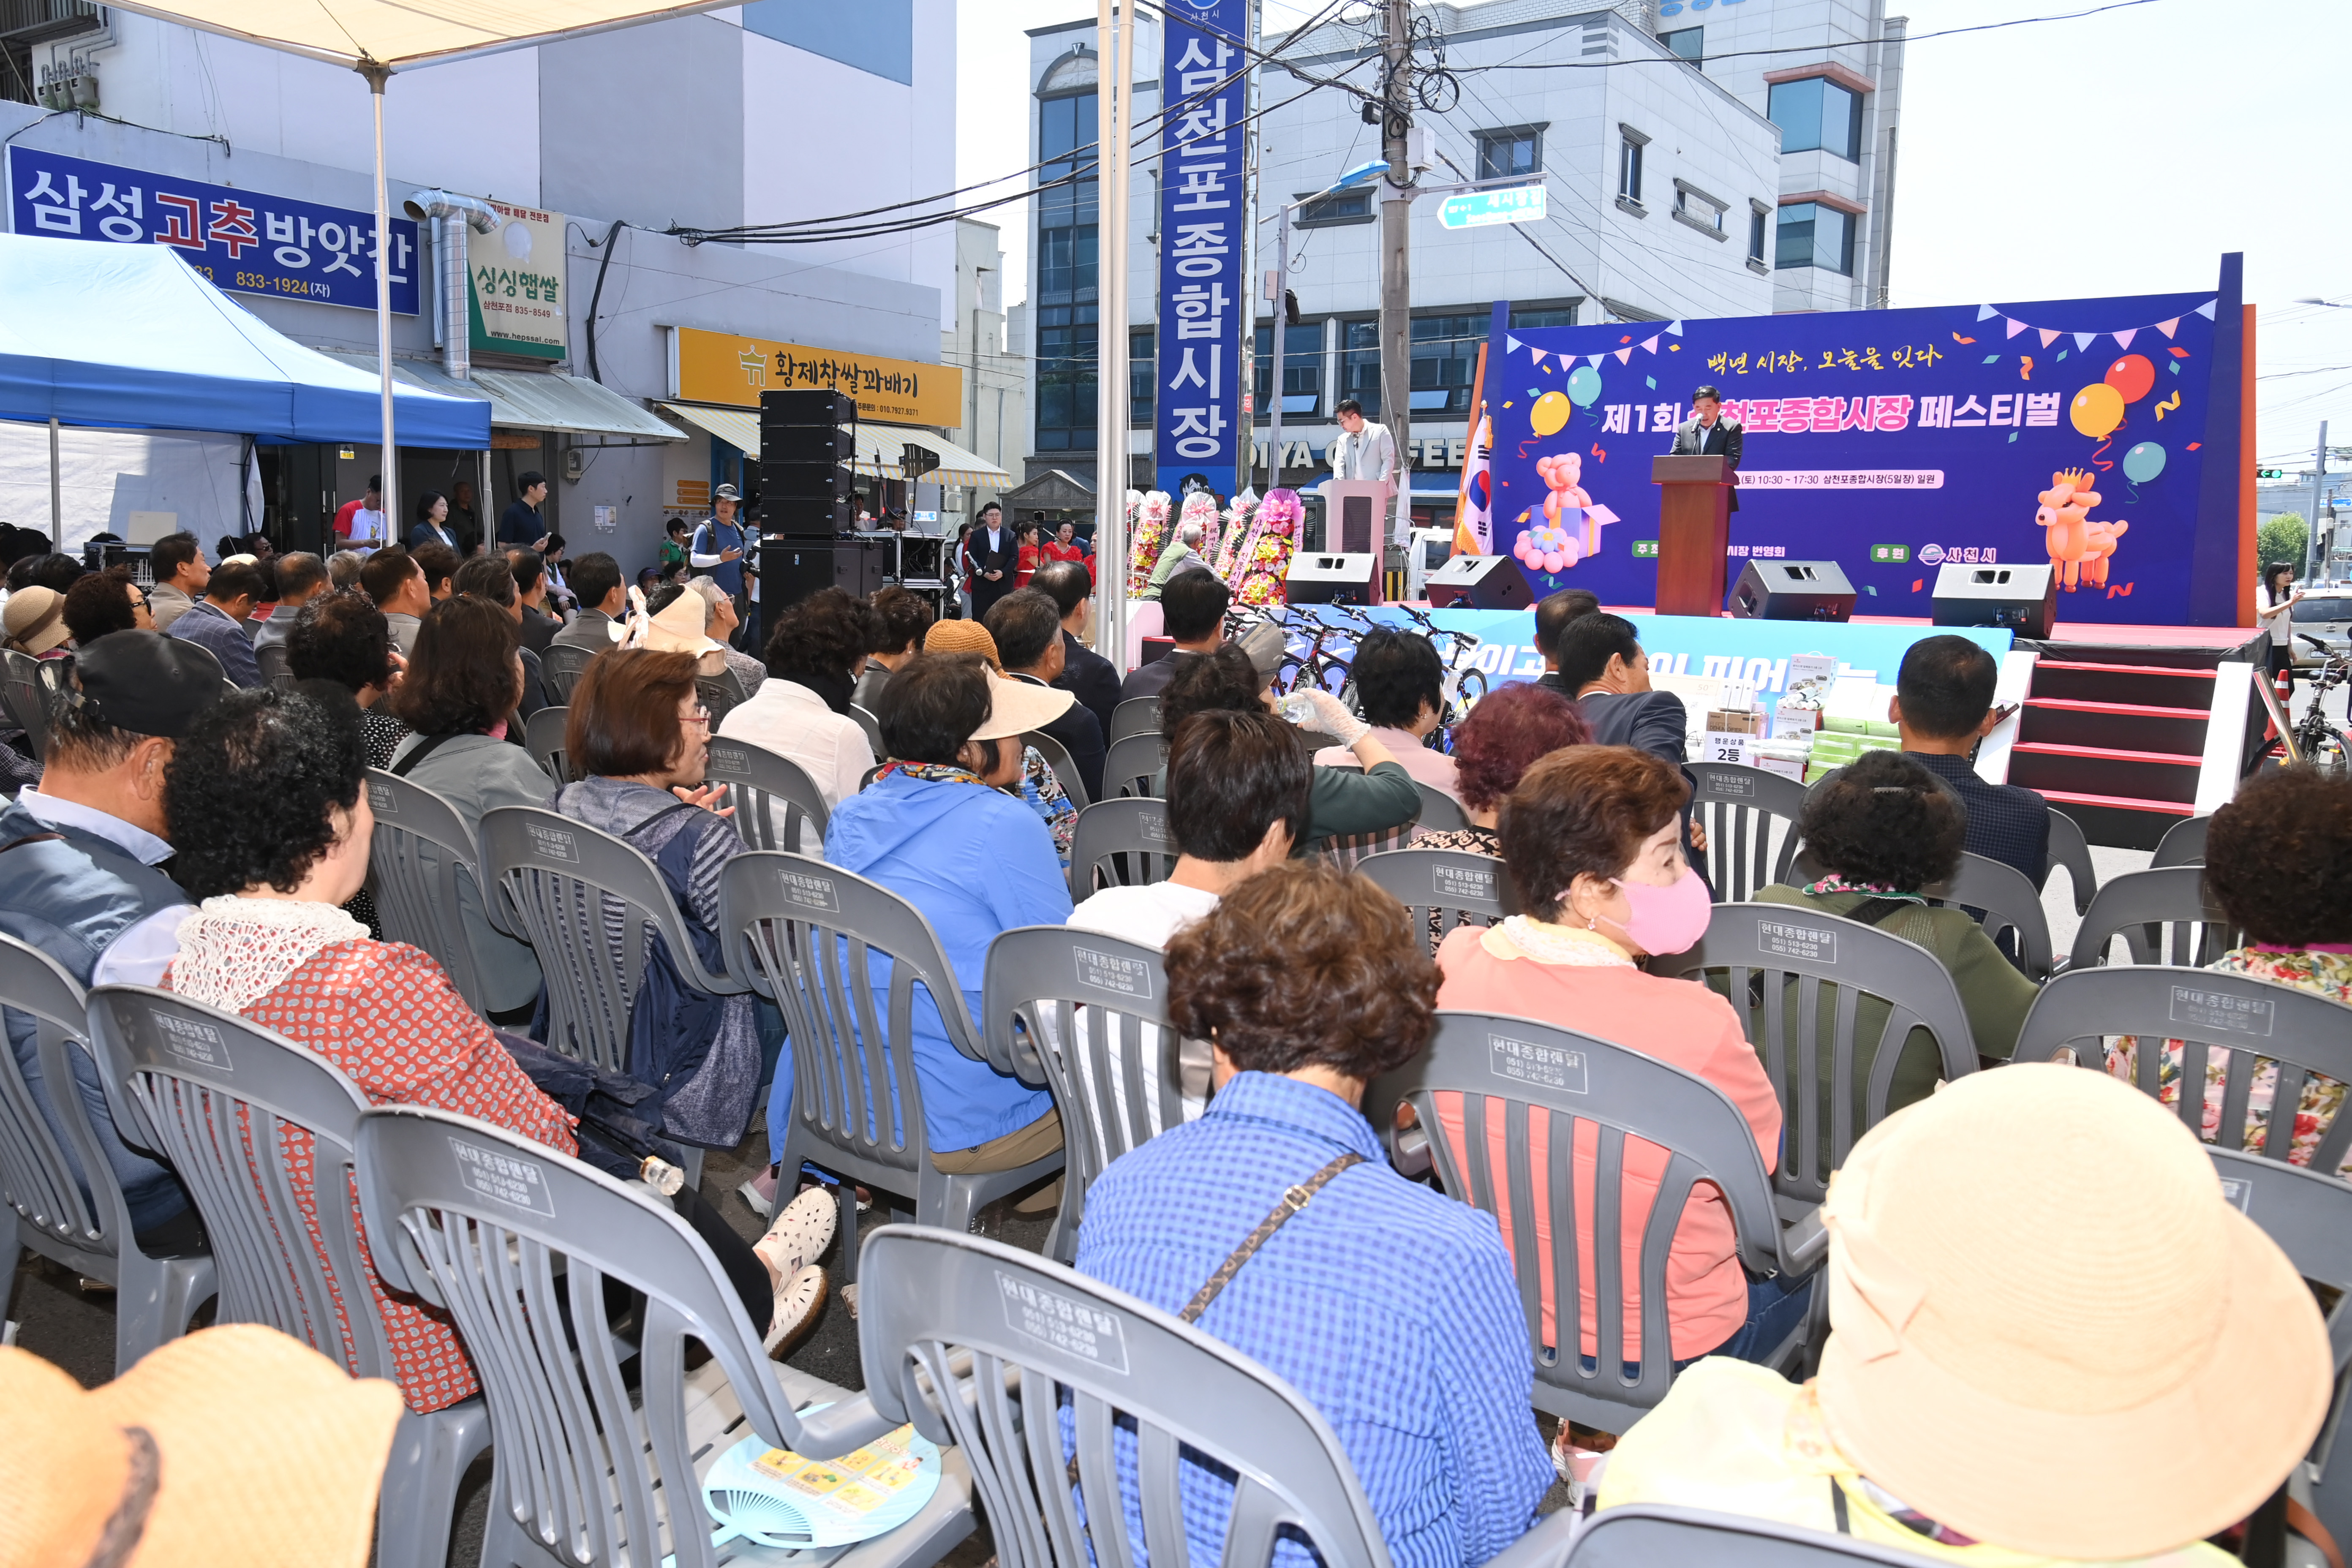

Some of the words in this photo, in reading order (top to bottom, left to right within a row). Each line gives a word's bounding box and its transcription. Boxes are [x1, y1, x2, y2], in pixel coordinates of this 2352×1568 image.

[1169, 34, 1234, 458] 삼천포종합시장
[483, 300, 512, 313] 삼천포점
[514, 306, 551, 318] 835-8549
[490, 331, 560, 345] www.hepssal.com
[1707, 351, 1748, 376] 백년
[1818, 346, 1884, 370] 오늘을
[1892, 343, 1944, 368] 잇다
[879, 405, 919, 416] 010.7927.9371
[1601, 402, 1681, 434] 제1회
[1688, 396, 1914, 434] 천포종합시장
[1917, 392, 2061, 429] 페스티벌
[1758, 475, 1783, 485] 10:30
[1794, 475, 1818, 485] 17:30
[1917, 474, 1935, 485] 일원
[1752, 545, 1786, 558] 번영회
[1718, 749, 1740, 762] 2등
[1709, 774, 1750, 785] 현대종합렌탈
[781, 872, 831, 893] 현대종합렌탈
[1435, 866, 1494, 885] 현대종합렌탈
[1444, 879, 1456, 887] 051)
[1458, 881, 1484, 890] 513-6230
[802, 888, 824, 899] 513-6230
[1458, 887, 1484, 897] 742-6230
[1761, 923, 1831, 944] 현대종합렌탈
[1771, 936, 1786, 946] 051)
[1787, 939, 1818, 950] 513-6230
[1771, 944, 1786, 953] 055)
[1787, 946, 1818, 958] 742-6230
[1105, 977, 1134, 992] 742-6230
[1492, 1037, 1579, 1069] 현대종합렌탈
[1001, 1276, 1113, 1337] 현대종합렌탈
